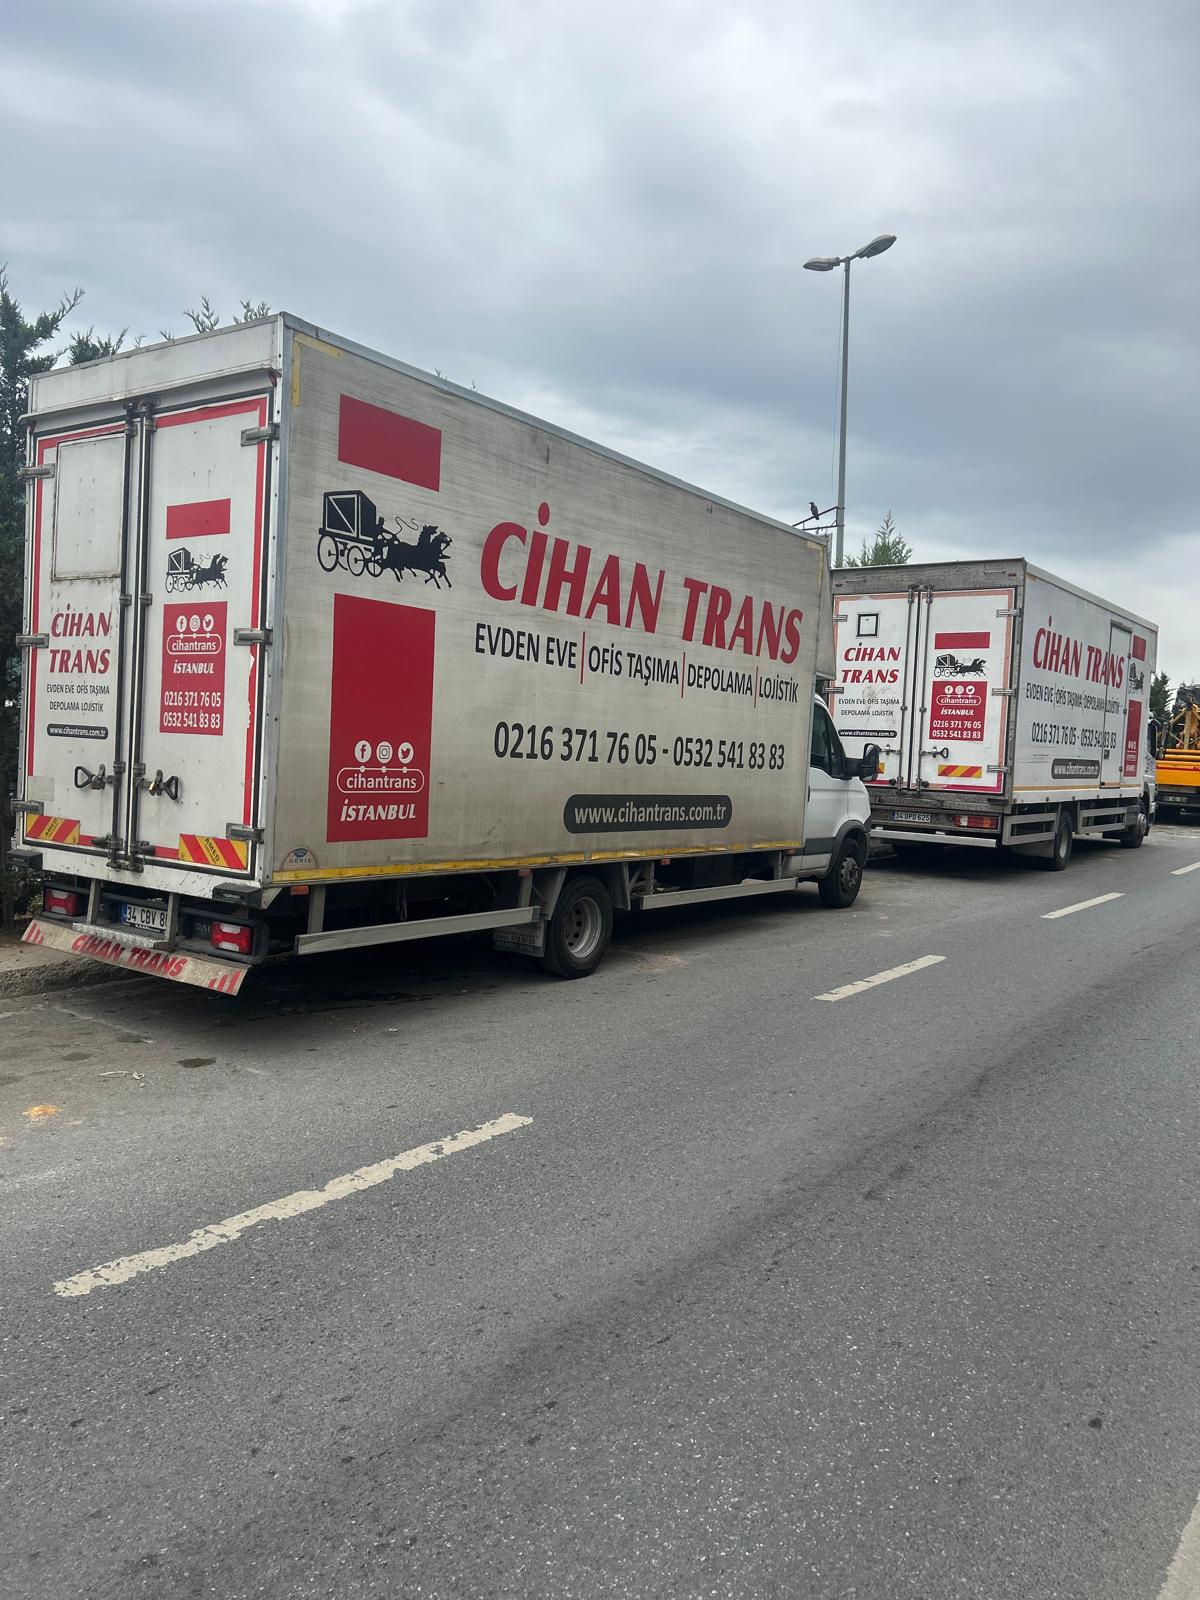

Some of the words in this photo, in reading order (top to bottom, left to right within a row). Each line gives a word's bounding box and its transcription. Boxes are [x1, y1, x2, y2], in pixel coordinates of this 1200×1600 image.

[480, 502, 665, 634] CİHAN
[682, 576, 803, 664] TRANS
[51, 603, 112, 637] CİHAN
[171, 639, 216, 651] cihantrans
[843, 642, 901, 662] CİHAN
[1033, 615, 1082, 678] CİHAN
[1085, 645, 1124, 689] TRANS
[49, 649, 111, 674] TRANS
[173, 659, 214, 674] İSTANBUL
[475, 622, 540, 662] EVDEN
[546, 636, 577, 669] EVE
[588, 643, 622, 676] OFİS
[627, 652, 679, 686] TAŞIMA
[687, 663, 753, 697] DEPOLAMA
[759, 674, 799, 703] LOJİSTİK
[841, 669, 899, 684] TRANS
[46, 684, 63, 693] EVDEN
[65, 684, 75, 694] EVE
[164, 691, 183, 706] 0216
[184, 691, 198, 706] 371
[200, 692, 210, 707] 76
[211, 692, 221, 707] 05
[1026, 682, 1043, 701] EVDEN
[1044, 686, 1054, 703] EVE
[49, 701, 79, 711] DEPOLAMA
[163, 711, 182, 726] 0532
[183, 712, 198, 727] 541
[199, 713, 209, 728] 83
[210, 713, 220, 728] 83
[932, 720, 949, 728] 0216
[950, 720, 962, 728] 371
[963, 720, 972, 728] 76
[973, 721, 981, 729] 05
[49, 726, 106, 737] www.cihantrans.com.tr
[932, 729, 948, 738] 0532
[949, 730, 962, 738] 541
[963, 730, 971, 739] 83
[972, 730, 981, 739] 83
[1031, 721, 1048, 743] 0216
[1048, 723, 1060, 744] 371
[1061, 726, 1069, 745] 76
[1069, 726, 1077, 746] 05
[1080, 728, 1094, 747] 0532
[1110, 731, 1117, 749] 83
[494, 721, 553, 760] 0216
[560, 727, 598, 762] 371
[606, 731, 629, 764] 76
[635, 733, 657, 765] 05
[673, 736, 713, 768] 0532
[717, 740, 744, 768] 541
[748, 742, 766, 770] 83
[769, 743, 785, 770] 83
[346, 773, 417, 789] cihantrans
[340, 799, 416, 822] İSTANBUL
[574, 801, 726, 824] www.cihantrans.com.tr
[205, 838, 220, 862] AMED
[127, 905, 137, 922] 34
[140, 908, 156, 925] CBV
[127, 946, 188, 977] TRANS
